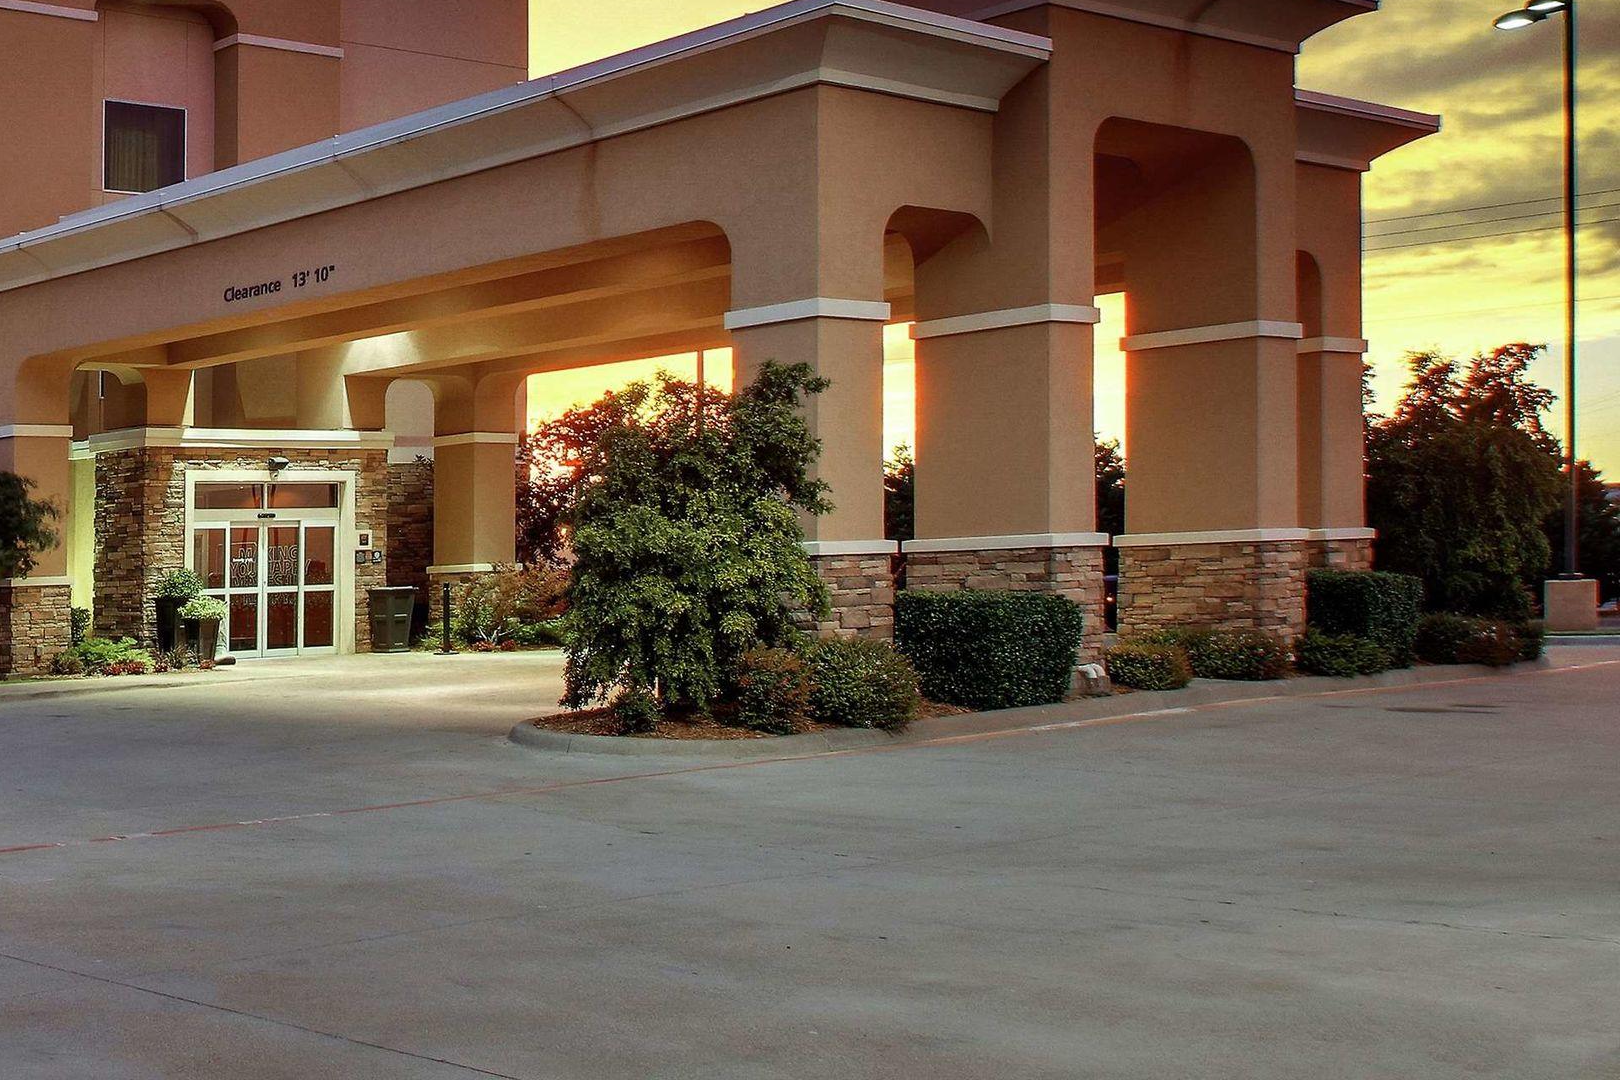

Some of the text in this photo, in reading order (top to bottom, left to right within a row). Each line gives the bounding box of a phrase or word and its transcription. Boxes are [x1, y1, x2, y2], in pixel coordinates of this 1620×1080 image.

[223, 264, 335, 302] Clearance 13' 10"
